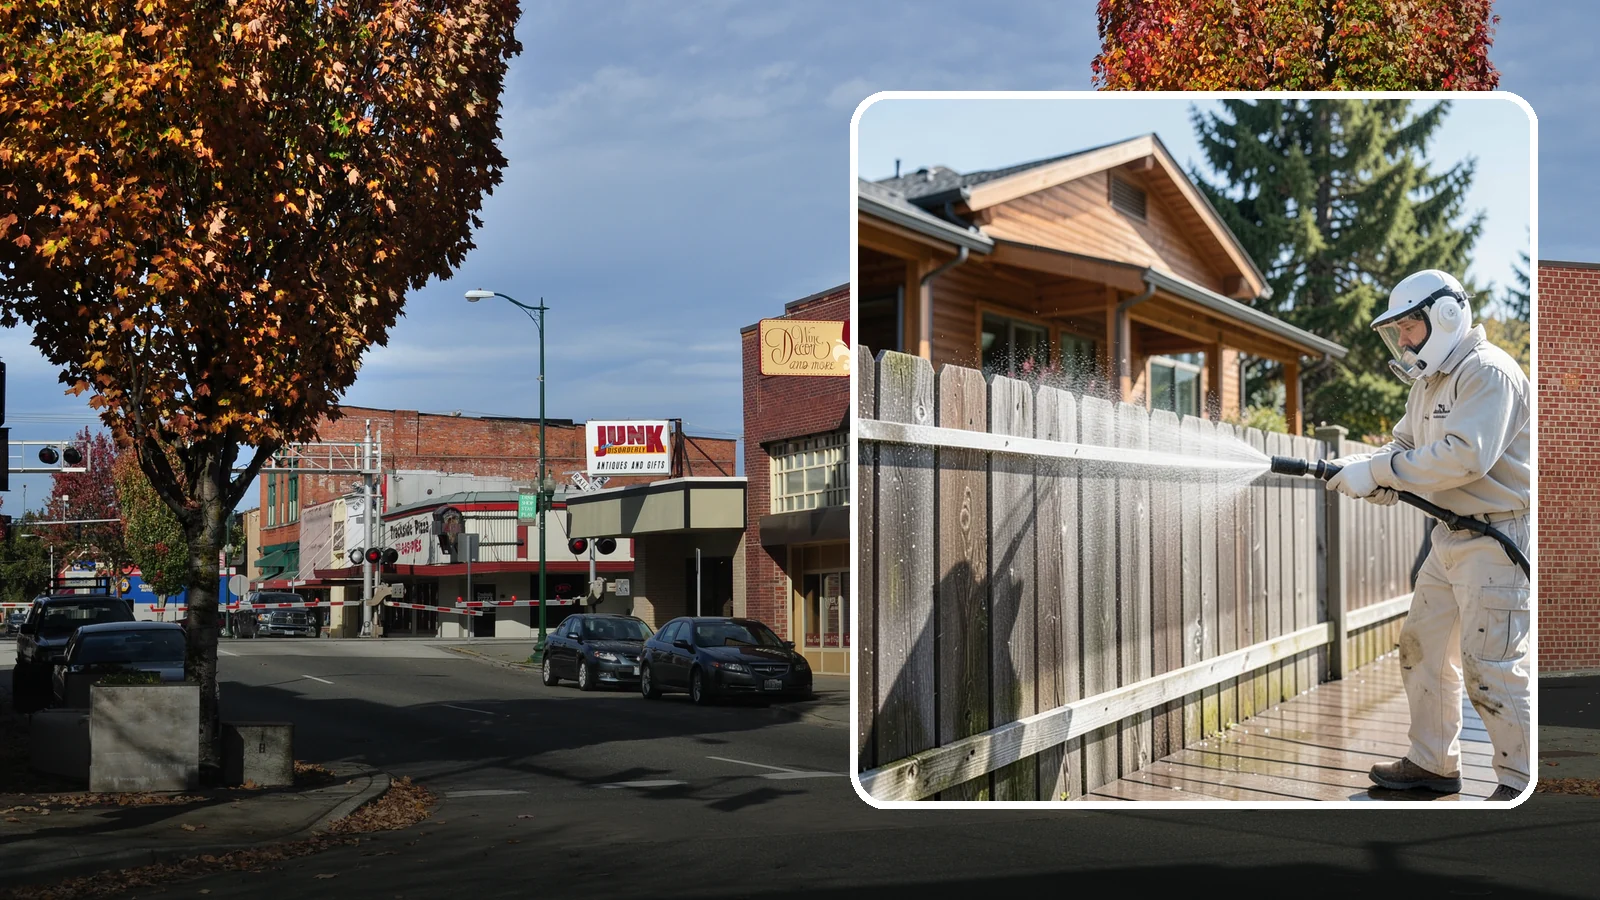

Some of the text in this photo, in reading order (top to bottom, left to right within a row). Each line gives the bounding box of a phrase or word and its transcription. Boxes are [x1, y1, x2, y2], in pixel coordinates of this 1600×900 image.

[595, 425, 665, 457] JUNK
[607, 446, 646, 454] DISORDERLY
[597, 460, 666, 470] ANTIQUES AND GIFTS
[414, 519, 429, 535] Pizza
